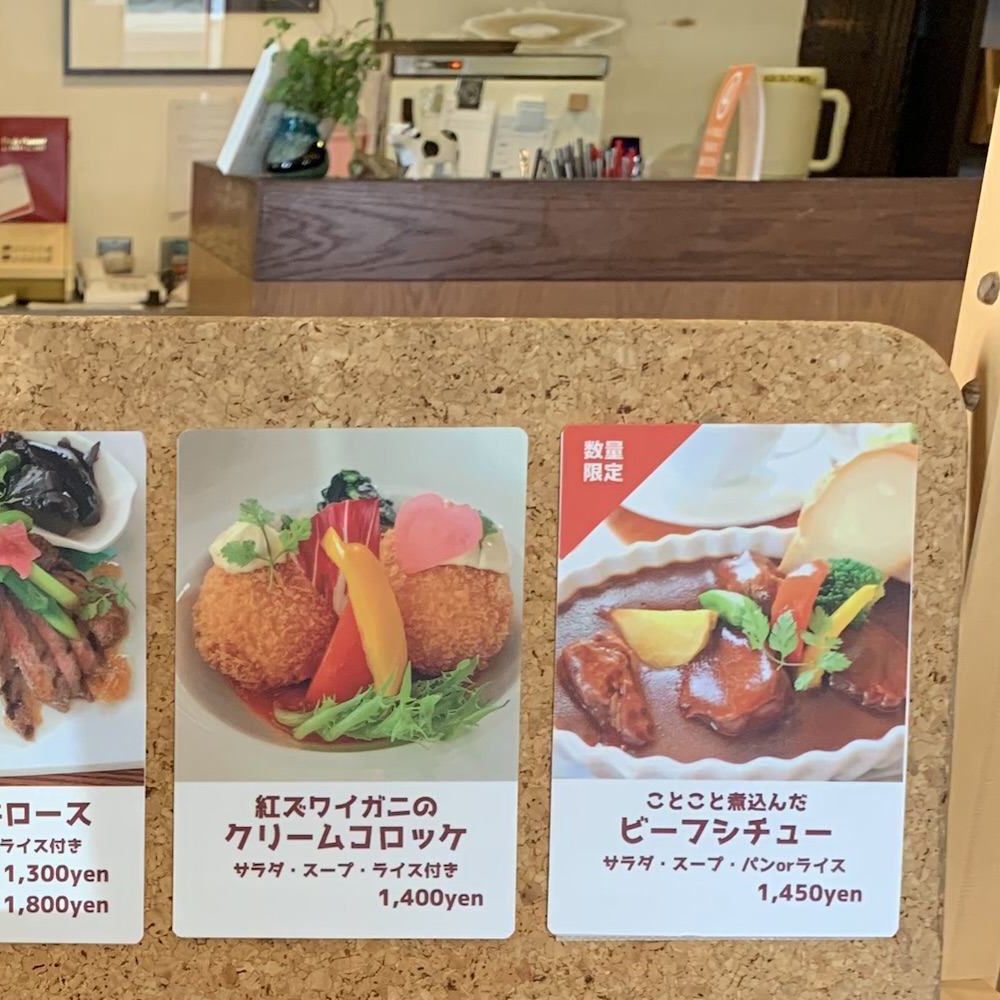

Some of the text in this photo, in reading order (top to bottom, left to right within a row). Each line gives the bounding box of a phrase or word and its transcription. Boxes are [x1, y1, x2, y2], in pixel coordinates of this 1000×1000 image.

[584, 440, 623, 459] 数量
[584, 463, 623, 482] 限定
[255, 795, 437, 819] 紅ズワイガニの
[647, 792, 807, 811] ことこと煮込んだ
[225, 824, 466, 851] クリームコロッケ
[622, 816, 831, 845] ビーフシチュー
[5, 865, 108, 887] 1,300yen
[379, 889, 483, 911] 1,400yen
[758, 884, 862, 906] 1,450yen
[5, 896, 108, 918] 1,800yen
